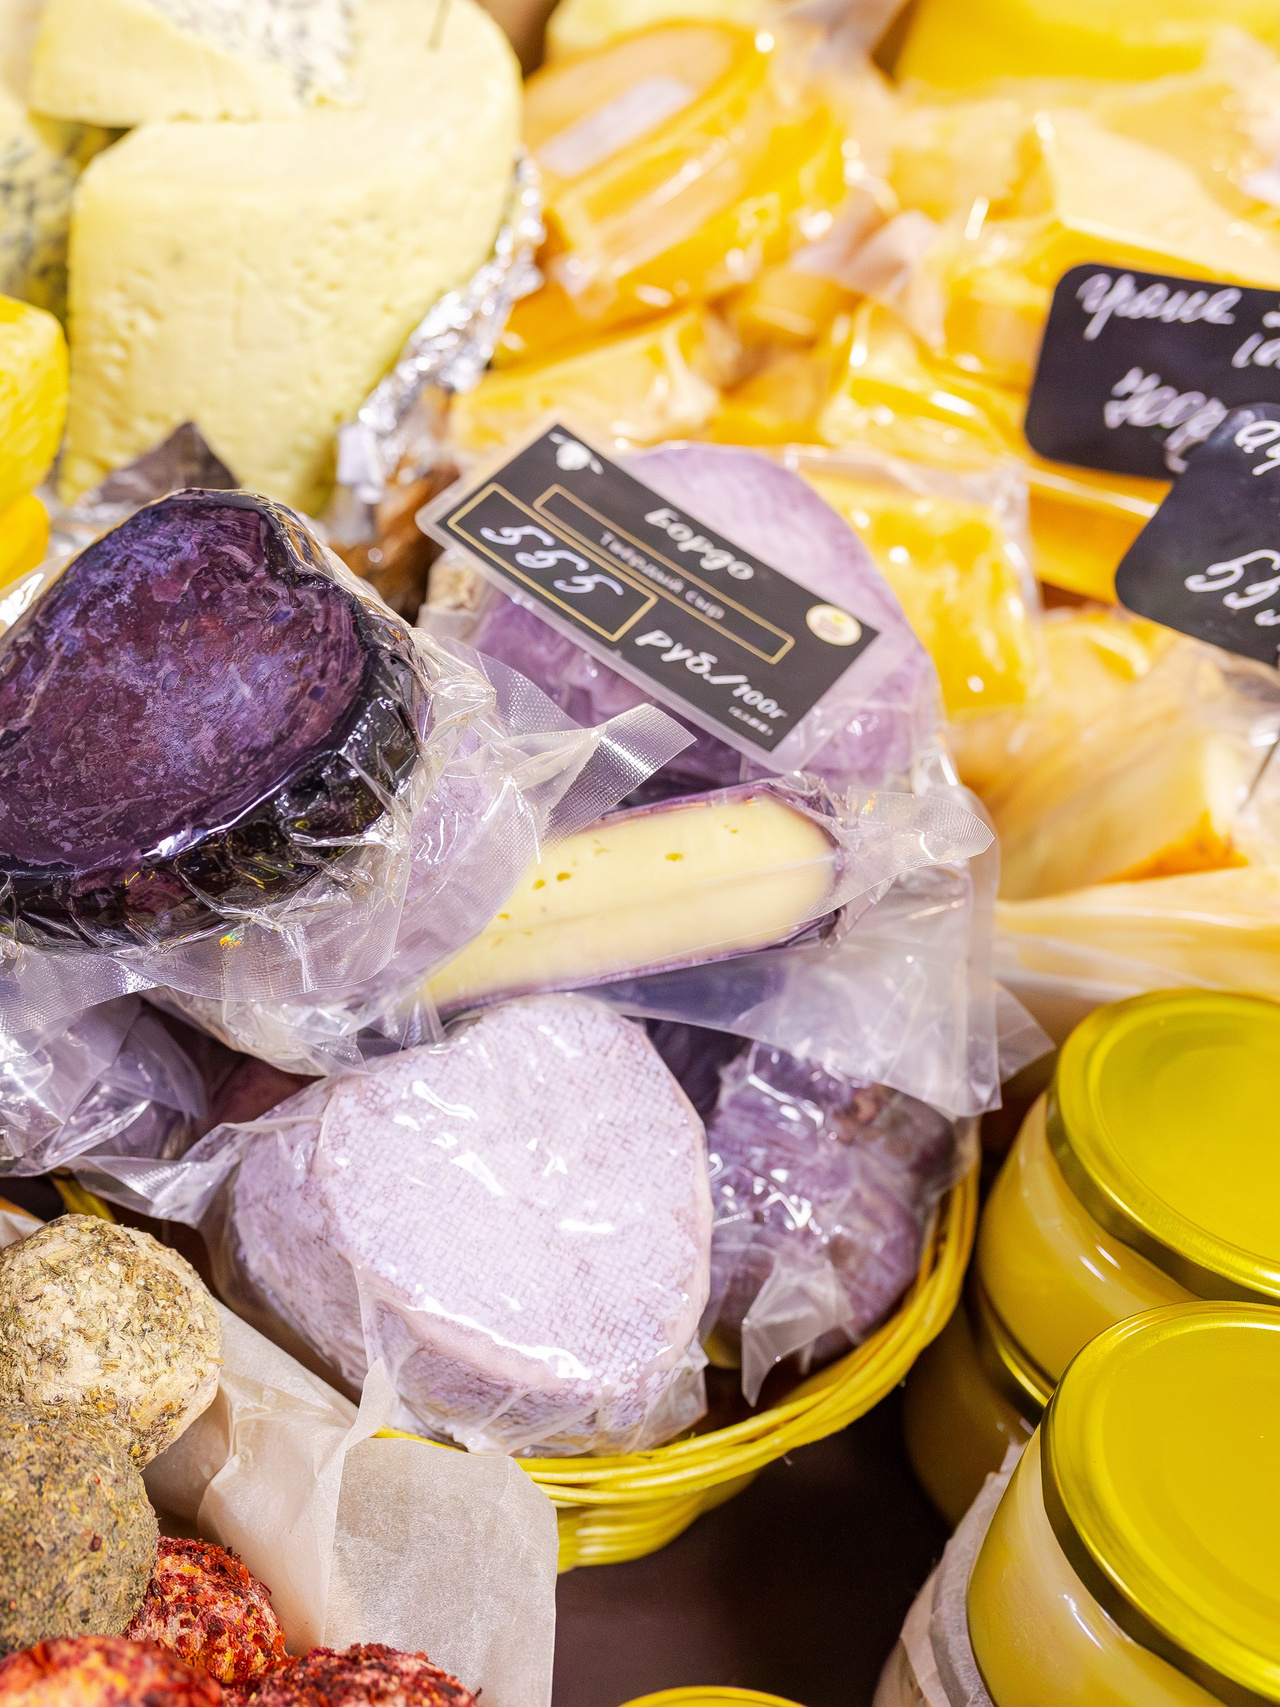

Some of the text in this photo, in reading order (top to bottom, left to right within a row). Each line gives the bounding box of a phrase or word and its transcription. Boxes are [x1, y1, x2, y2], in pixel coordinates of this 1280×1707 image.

[479, 524, 625, 597] 555
[644, 507, 756, 581] Бордо
[685, 588, 726, 621] сыр
